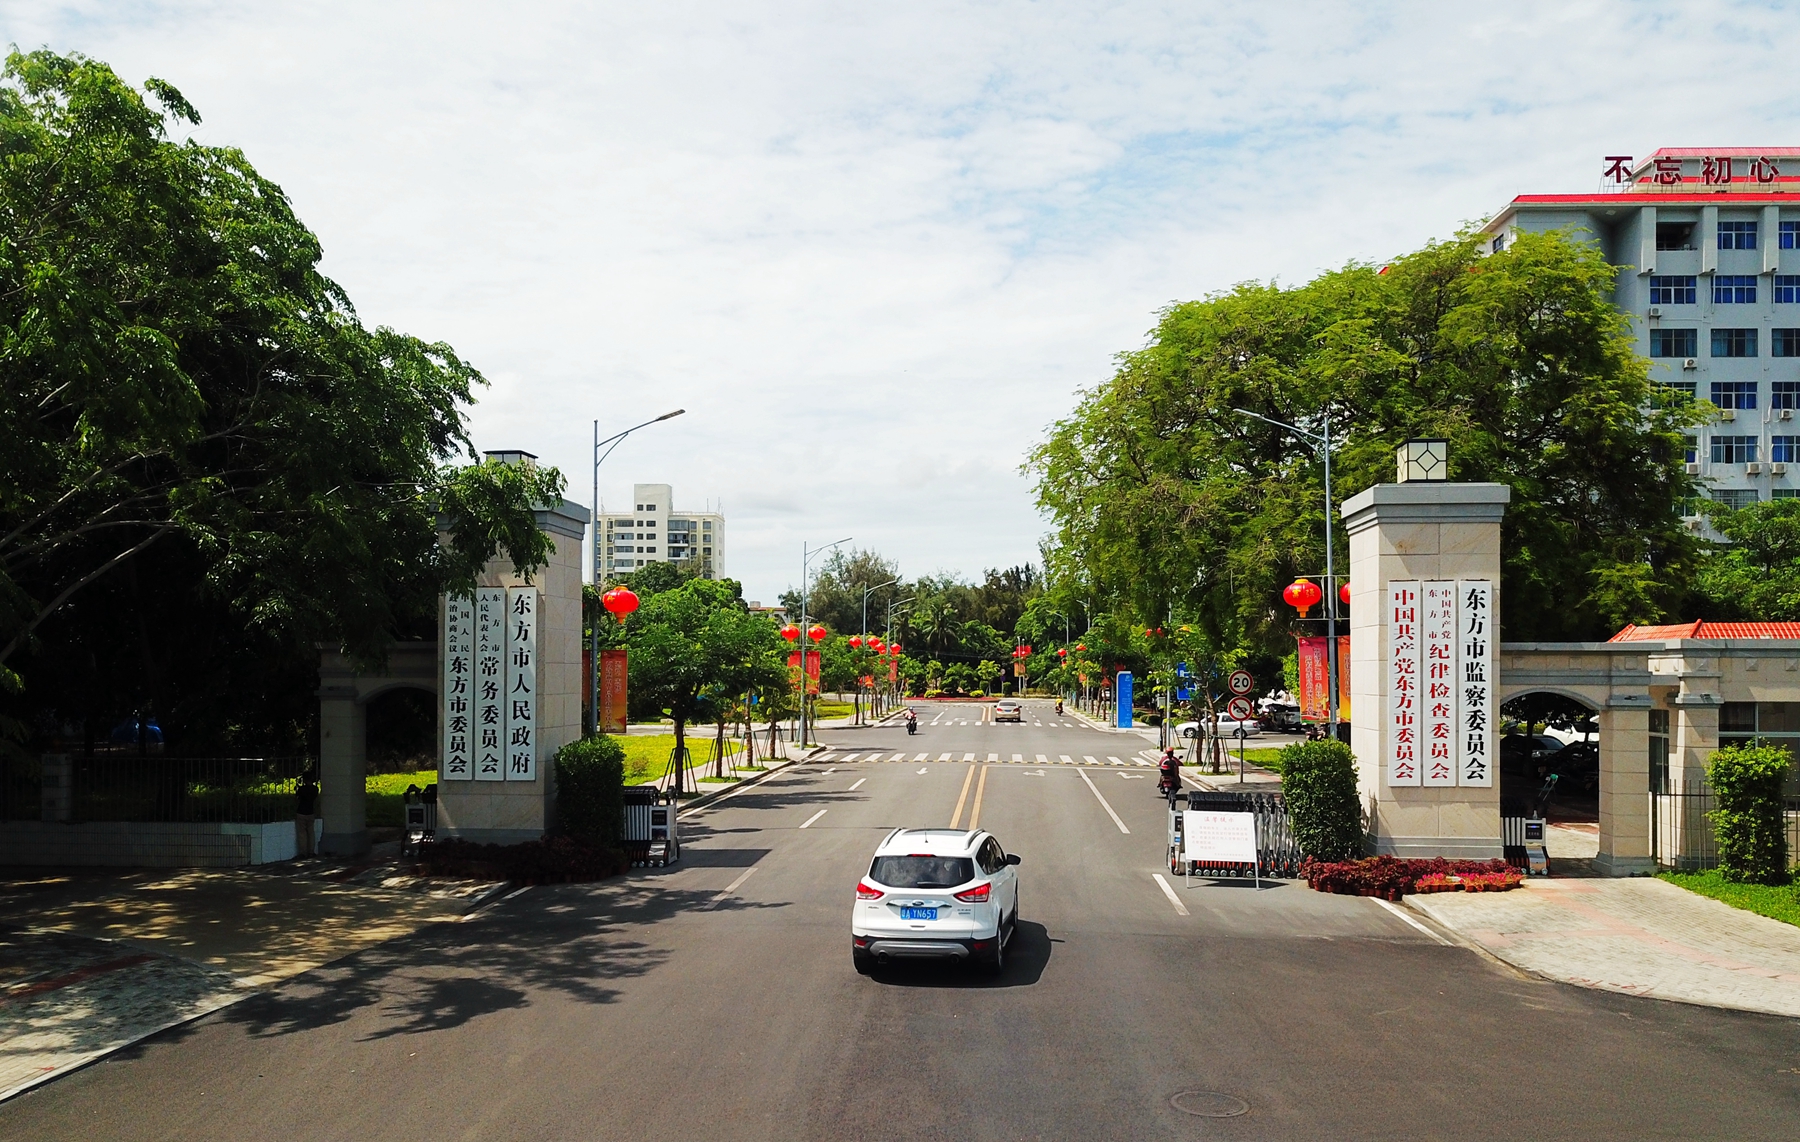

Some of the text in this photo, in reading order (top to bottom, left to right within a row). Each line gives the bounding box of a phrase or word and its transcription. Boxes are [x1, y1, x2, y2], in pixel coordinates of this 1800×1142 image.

[1603, 155, 1781, 186] 不忘初心
[460, 594, 469, 653] 中国人民
[480, 593, 489, 652] 人民代表大会
[491, 593, 501, 652] 东方市
[1428, 588, 1438, 640] 东方市
[1441, 588, 1452, 640] 中国共产党
[510, 593, 531, 774] 东方市人民政府
[1233, 677, 1249, 688] 20
[1393, 589, 1415, 779] 中国共产党东方市委员会
[1428, 643, 1451, 779] 纪律检查委员会
[1464, 588, 1487, 780] 东方市监察委员会
[448, 656, 469, 774] 东方市委员会
[479, 656, 499, 774] 常务委员会
